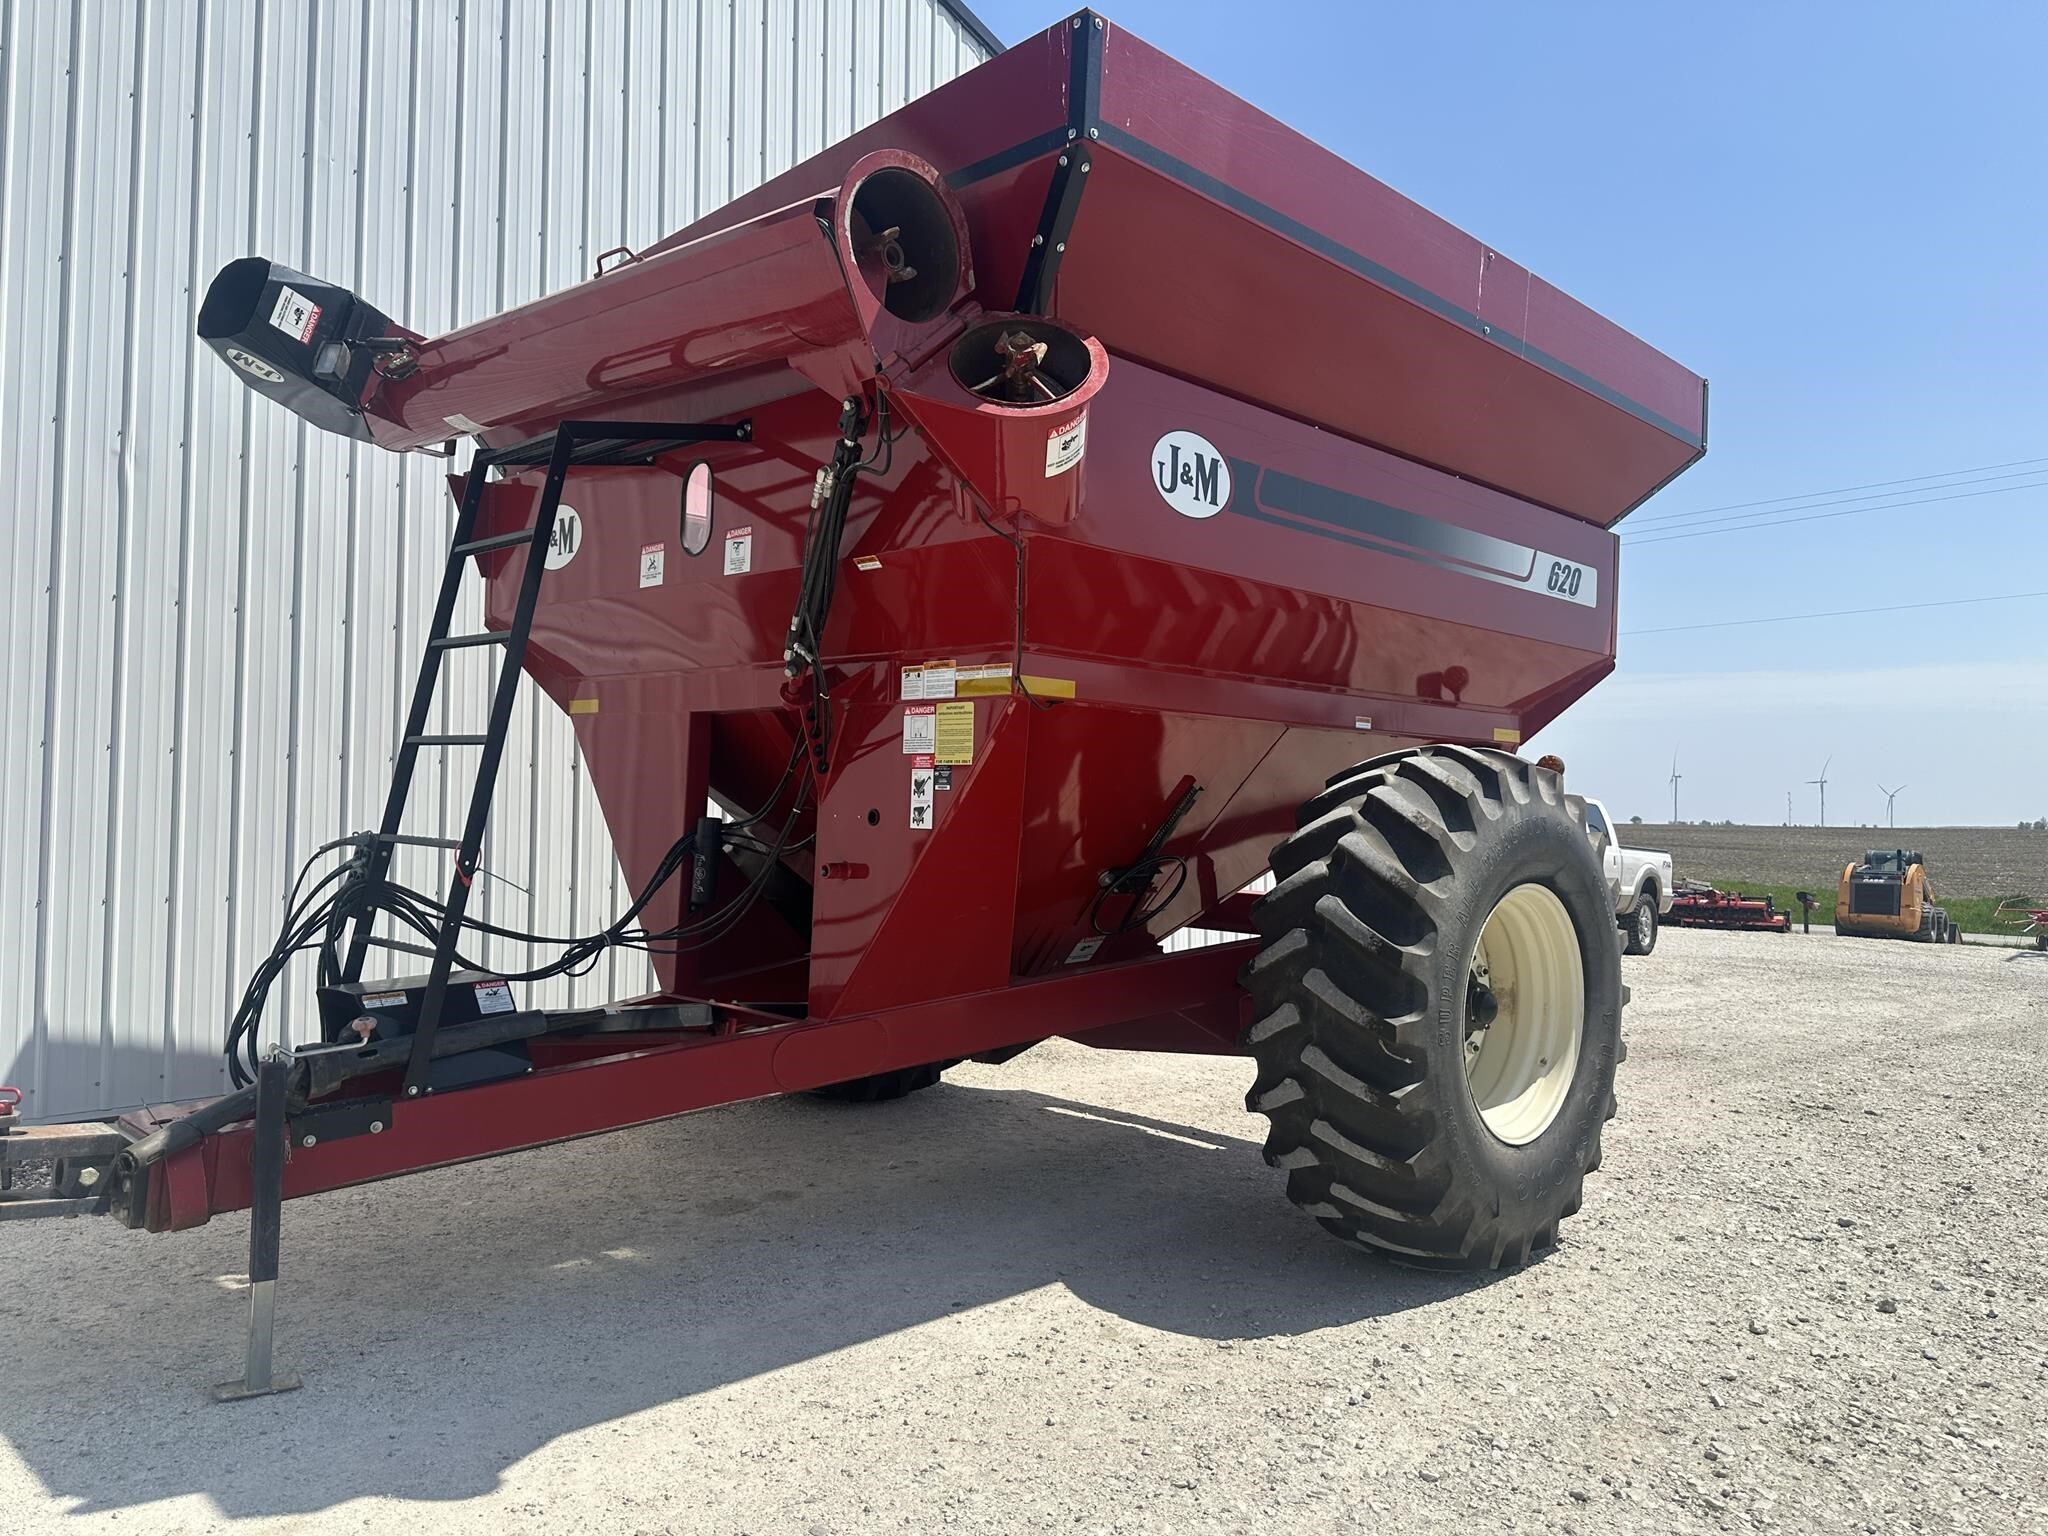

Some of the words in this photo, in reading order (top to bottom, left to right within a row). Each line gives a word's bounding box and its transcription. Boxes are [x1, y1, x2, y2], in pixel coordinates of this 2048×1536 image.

[301, 312, 321, 344] DANGER
[1058, 409, 1087, 436] DANGER
[1157, 443, 1221, 507] J&M
[549, 515, 576, 556] &M
[729, 526, 752, 538] DANGER
[645, 543, 665, 554] DANGER
[1547, 561, 1582, 597] 620
[910, 706, 935, 715] DANGER
[1438, 942, 1463, 1048] SUPER
[1455, 878, 1482, 929] ALL
[481, 980, 506, 988] DANGER
